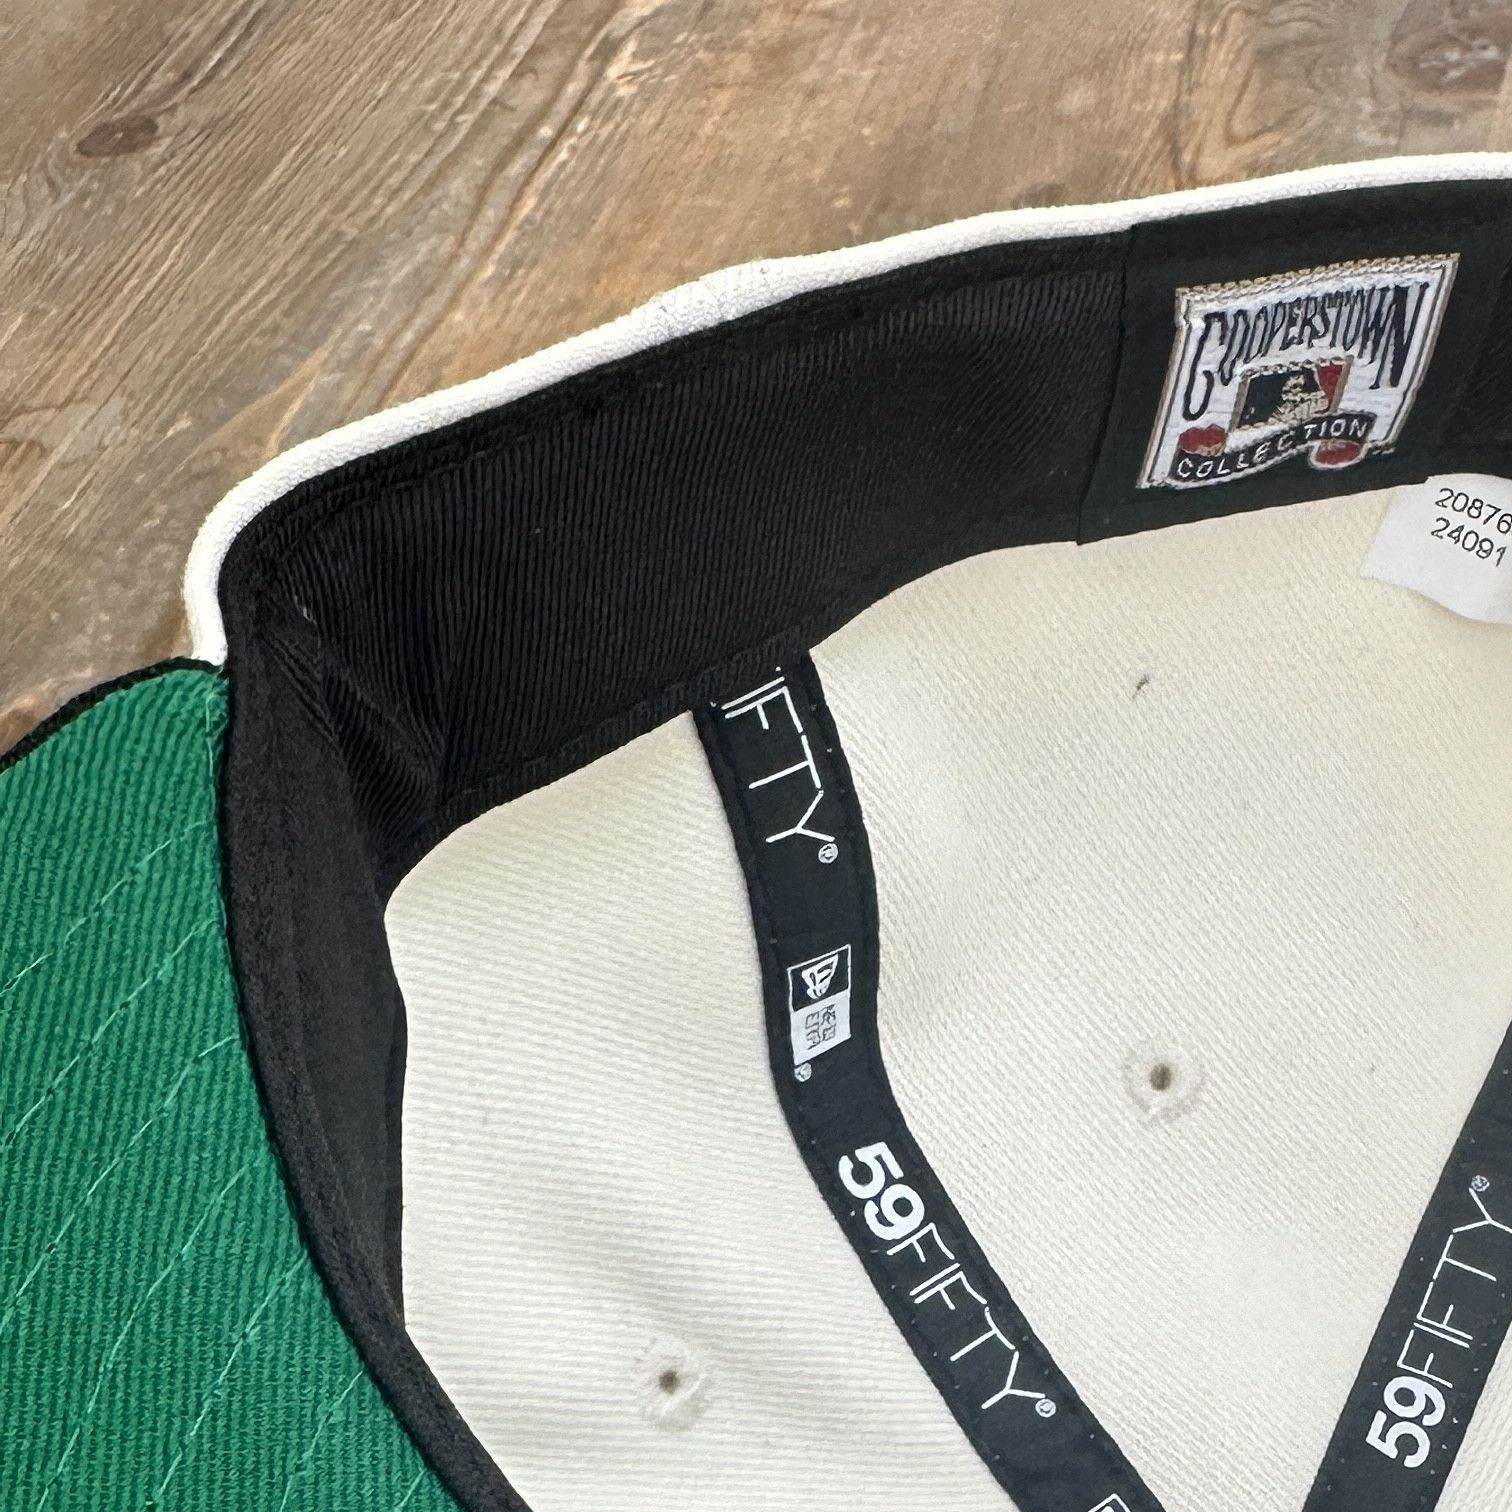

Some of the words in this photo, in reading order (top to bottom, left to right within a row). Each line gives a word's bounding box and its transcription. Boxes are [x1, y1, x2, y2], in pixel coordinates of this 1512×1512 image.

[1182, 281, 1430, 420] COOPERSTOWN
[1176, 419, 1368, 479] COLLECTION
[1430, 517, 1508, 569] 24091
[721, 666, 836, 843] IFTY
[838, 1141, 1046, 1410] 59FIFTY
